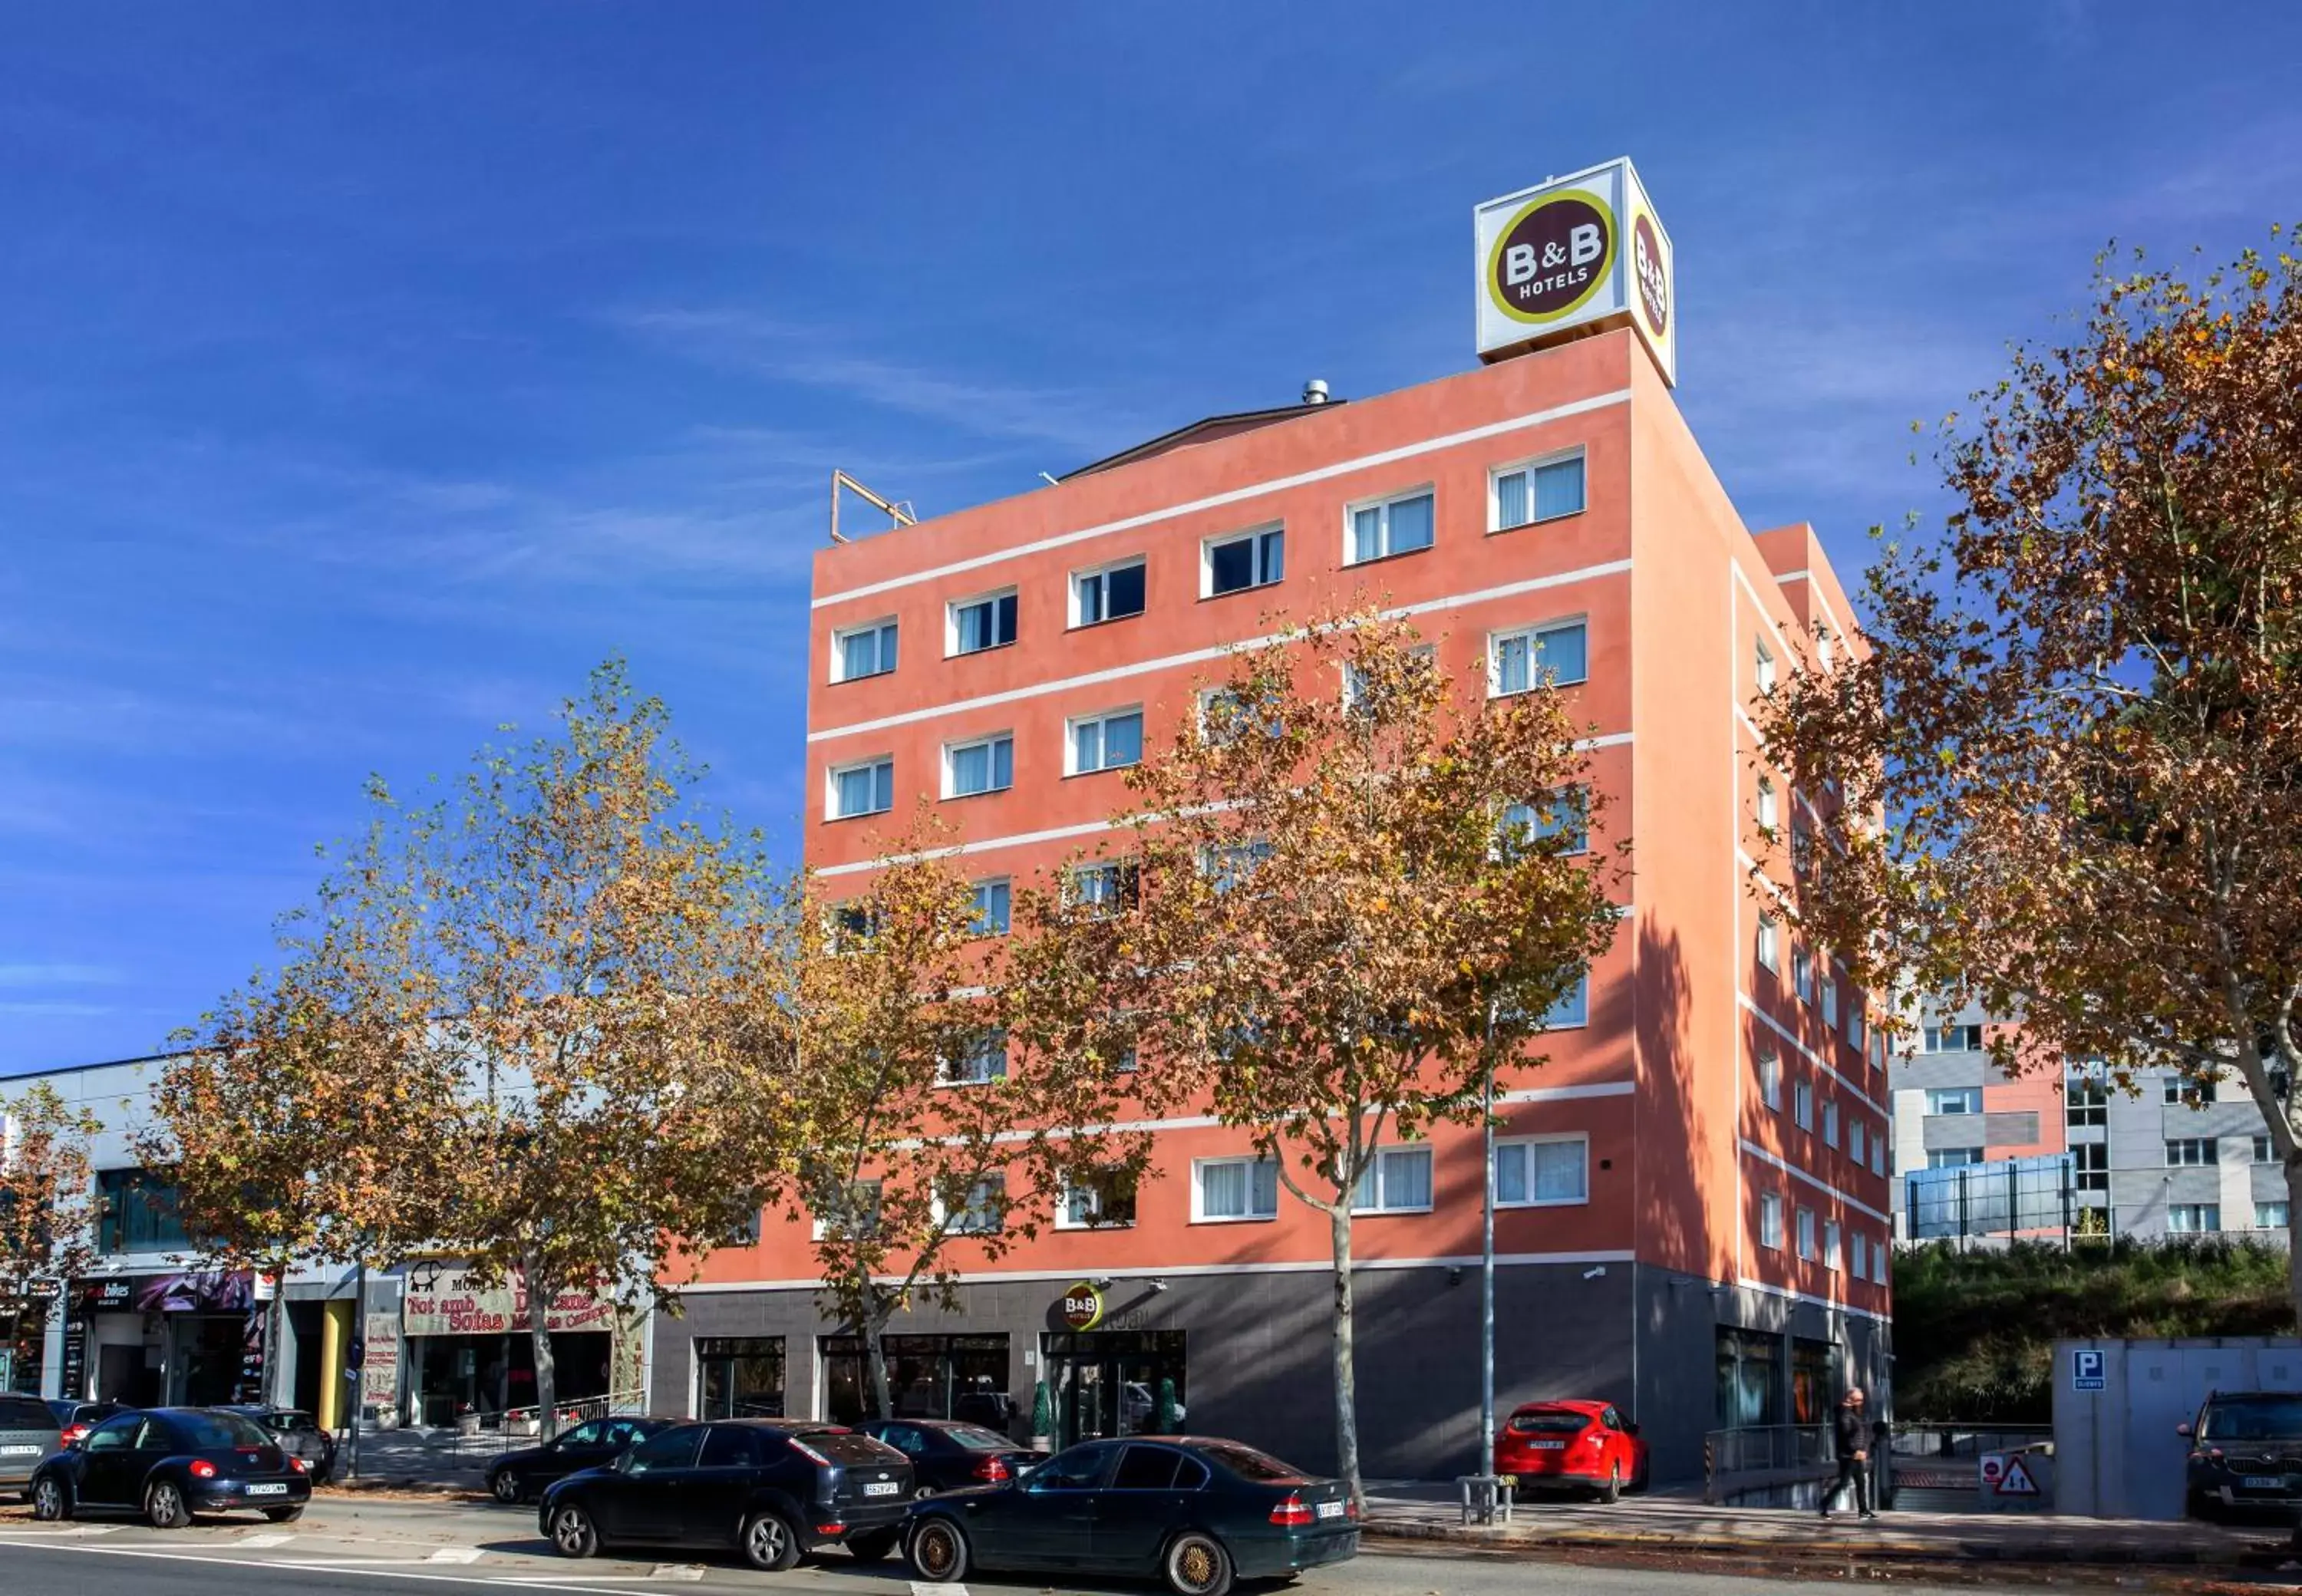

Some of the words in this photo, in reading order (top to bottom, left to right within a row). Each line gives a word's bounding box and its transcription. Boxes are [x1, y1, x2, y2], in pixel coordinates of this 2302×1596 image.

[1519, 268, 1588, 299] HOTELS
[1065, 1298, 1096, 1313] B&B
[2079, 1353, 2098, 1377] P
